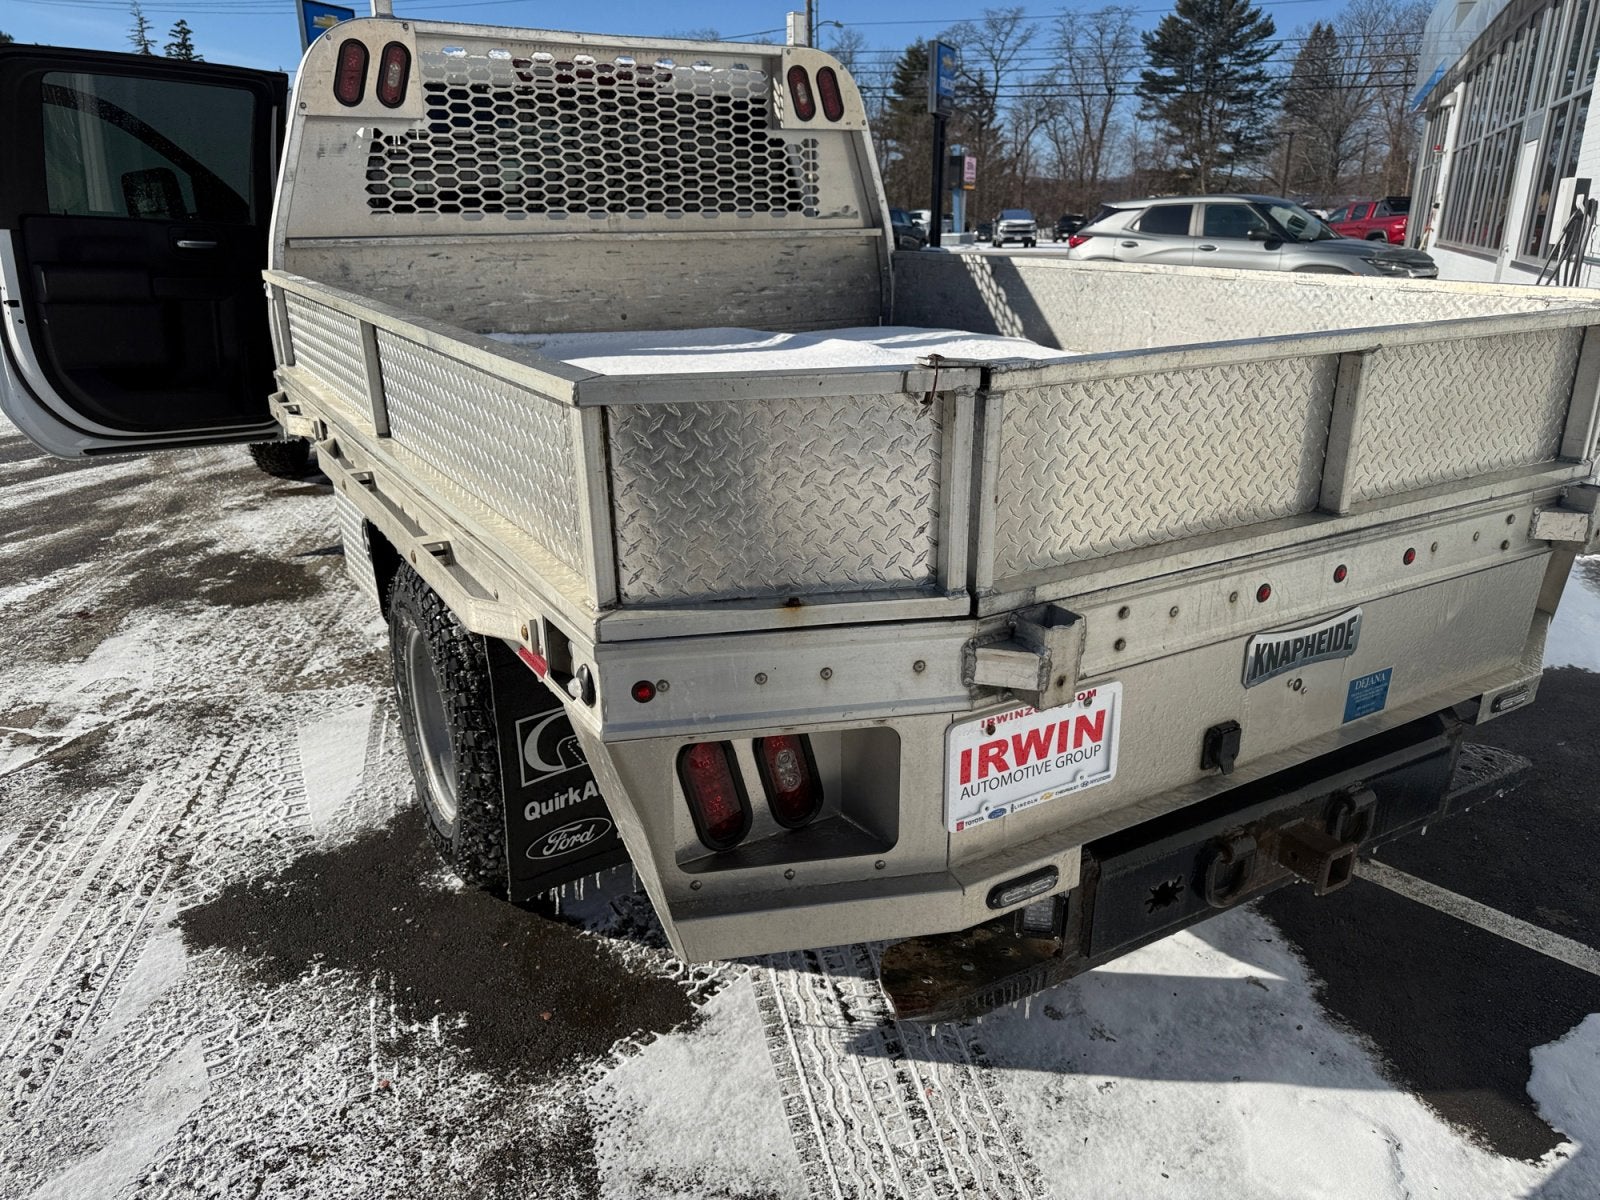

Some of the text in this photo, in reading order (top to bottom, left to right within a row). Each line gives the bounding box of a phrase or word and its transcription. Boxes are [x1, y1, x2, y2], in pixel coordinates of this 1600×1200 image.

[1252, 616, 1357, 680] KNAPHEIDE
[1355, 672, 1386, 690] DEJANA
[981, 689, 1097, 729] IRWINZOM
[959, 709, 1106, 785] IRWIN
[960, 744, 1102, 800] AUTOMOTIVE GROUP
[524, 780, 600, 821] QuirkA
[965, 816, 985, 827] TOYOTA
[1014, 798, 1038, 810] LINCOLN
[542, 823, 596, 856] Ford
